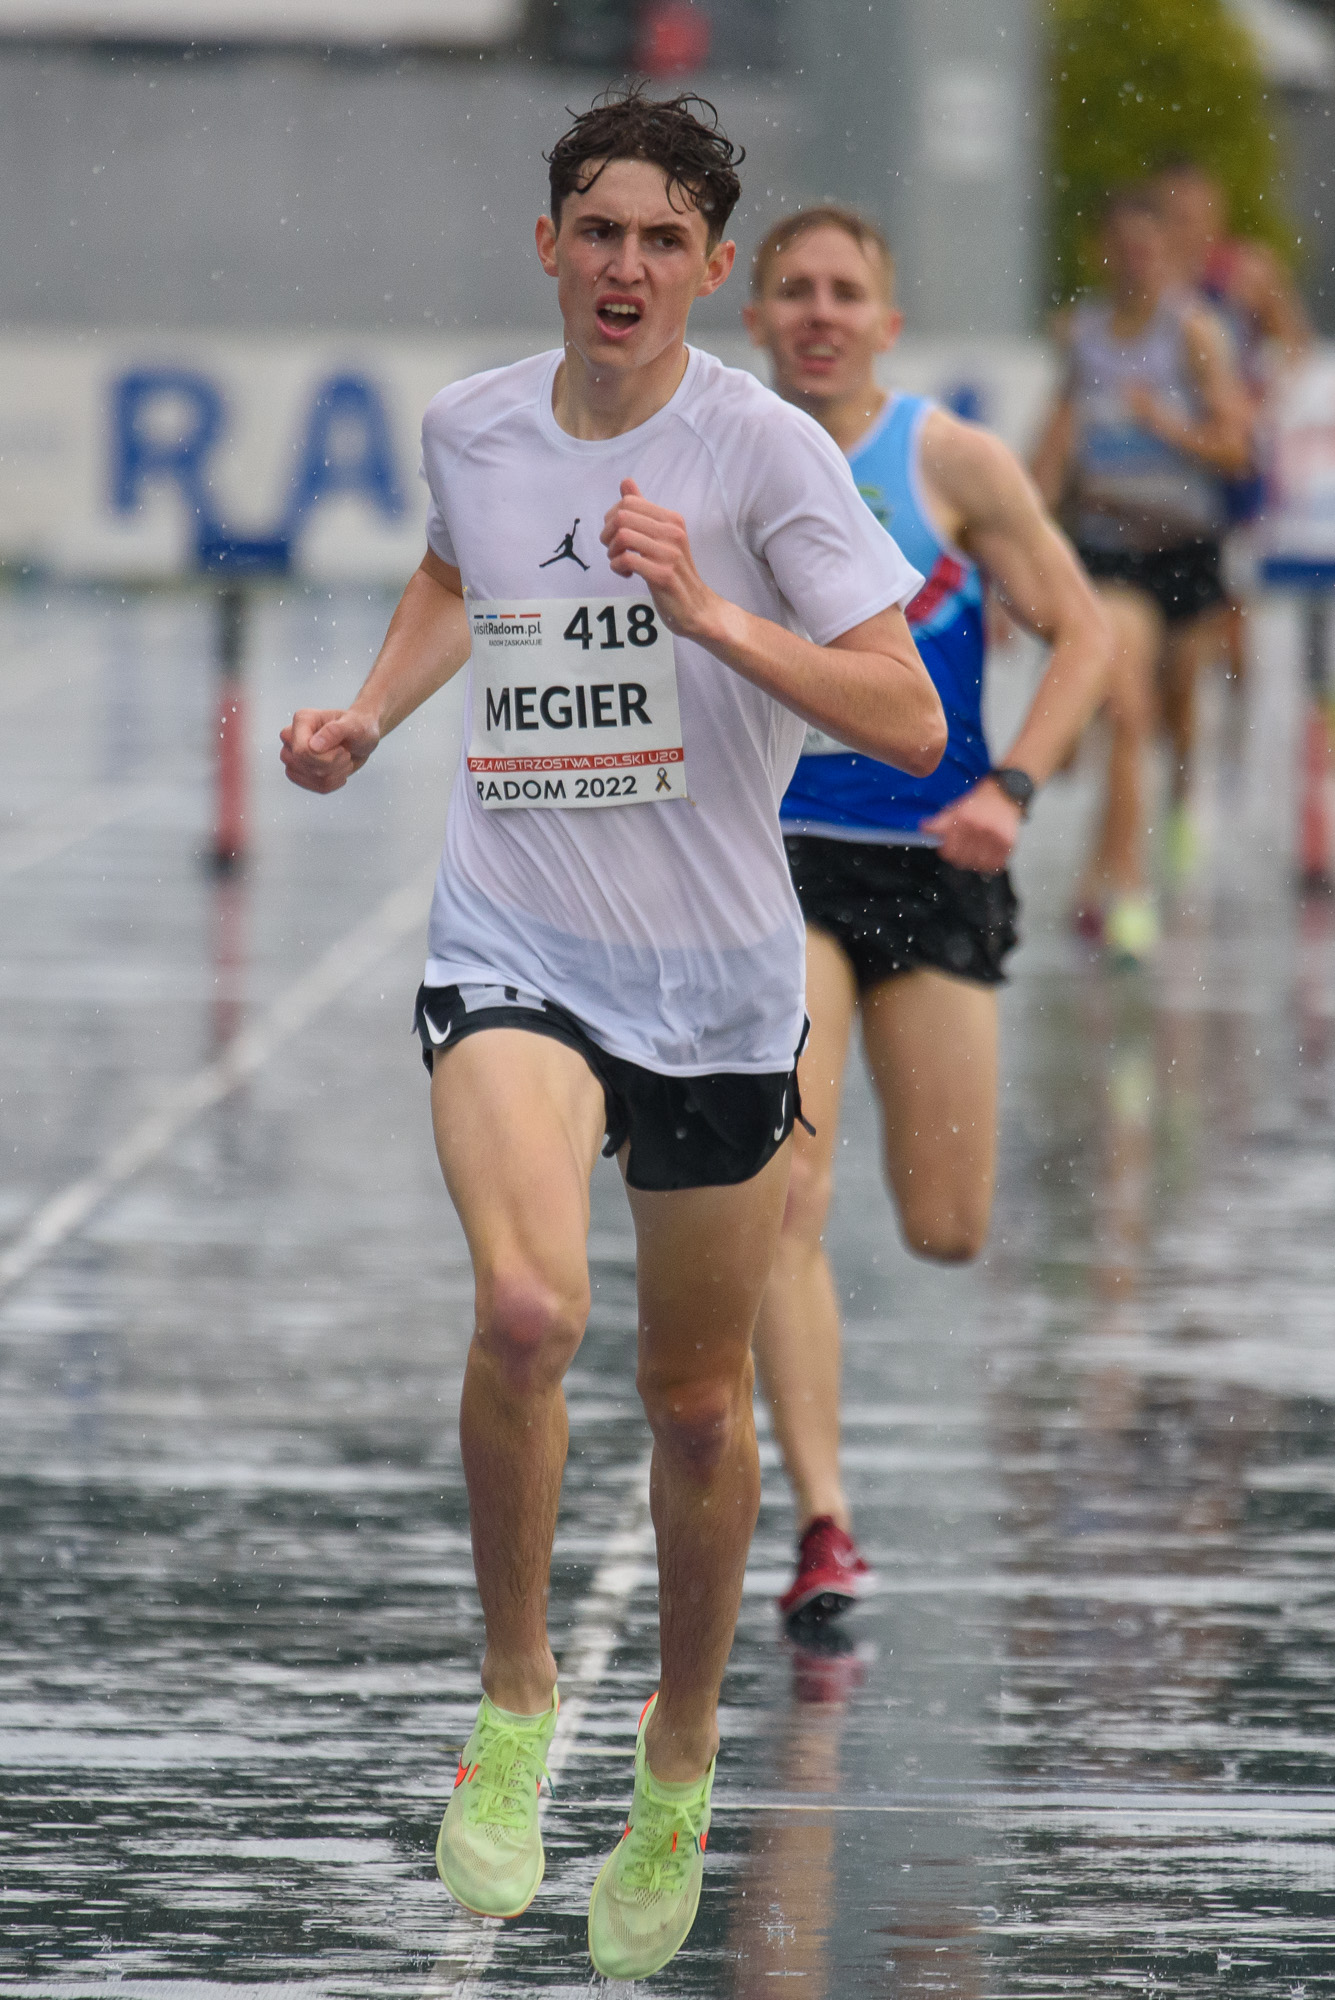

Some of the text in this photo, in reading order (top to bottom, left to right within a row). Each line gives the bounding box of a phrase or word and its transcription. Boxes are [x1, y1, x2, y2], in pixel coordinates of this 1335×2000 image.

[473, 621, 541, 637] visitRadom.pl
[563, 604, 658, 650] 418
[486, 682, 652, 731] MEGIER
[470, 750, 679, 771] PZLA MISTRZOSTWA POLSKI U20
[476, 775, 638, 801] RADOM 2022
